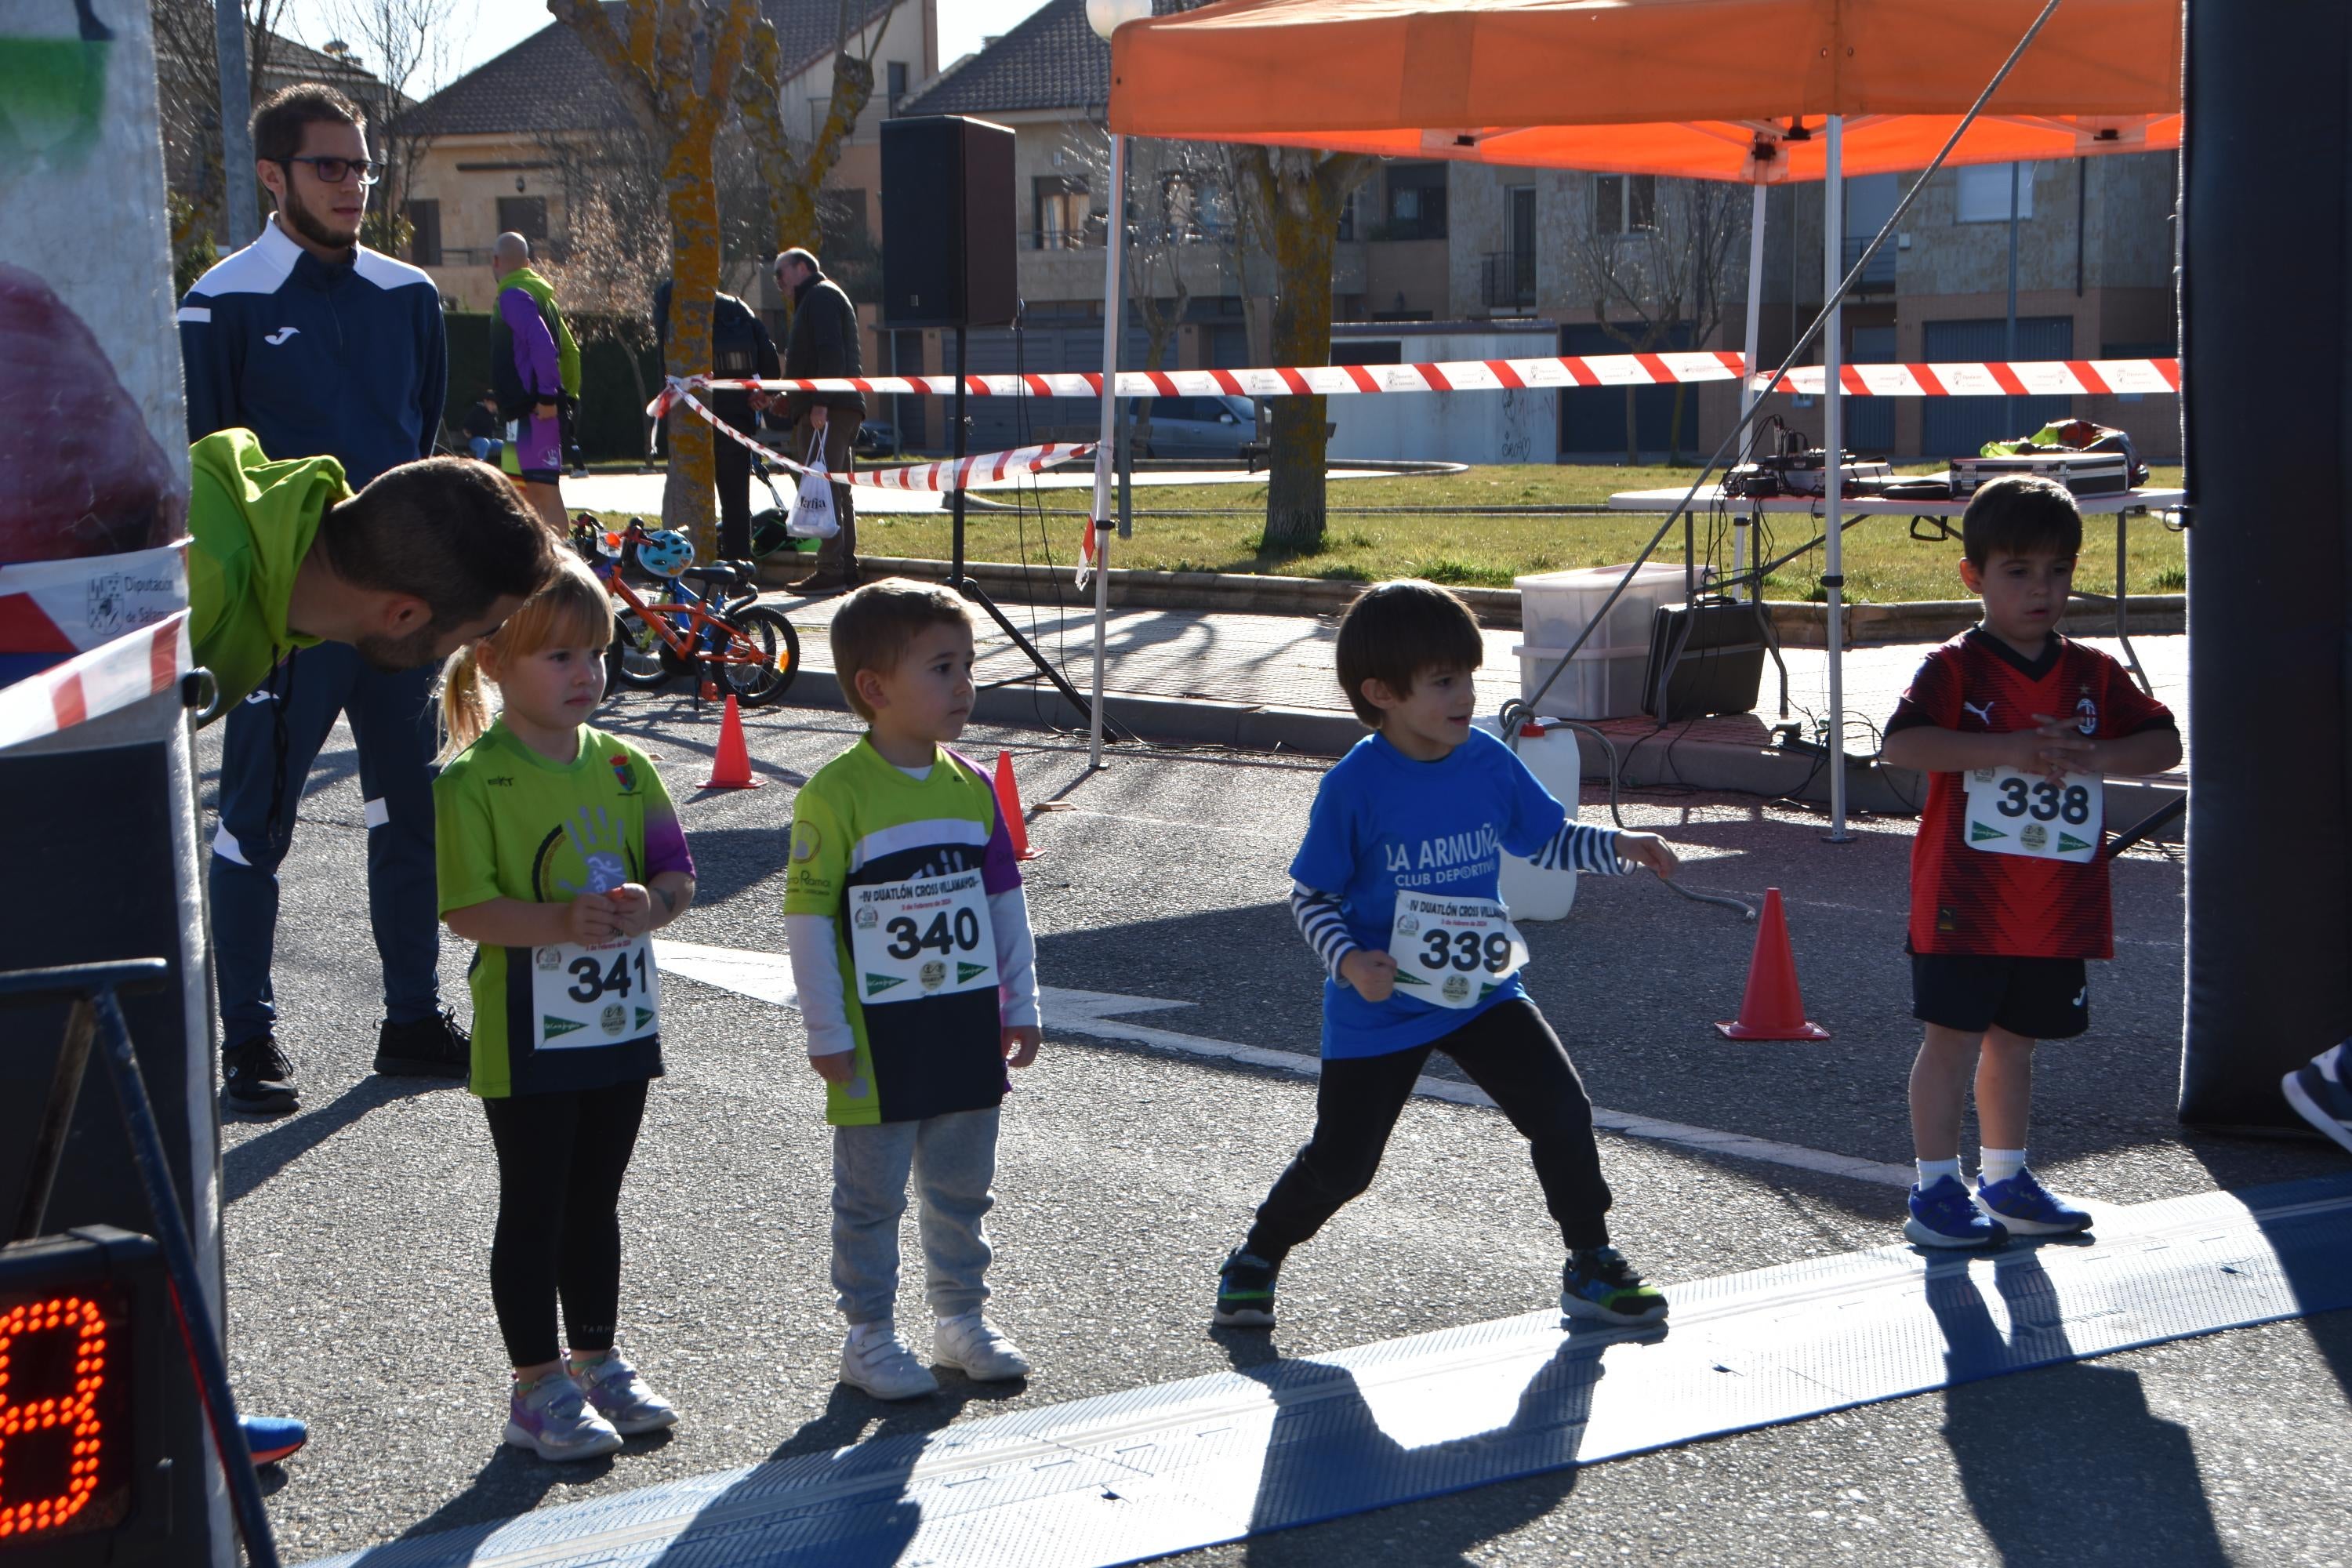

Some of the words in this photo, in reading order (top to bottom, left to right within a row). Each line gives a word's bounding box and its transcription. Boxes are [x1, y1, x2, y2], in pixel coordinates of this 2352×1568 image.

[1996, 777, 2089, 825] 338
[1385, 843, 1411, 872] LA
[873, 884, 913, 901] DUATLÓN
[915, 883, 939, 898] CROSS
[1395, 873, 1431, 887] CLUB
[1420, 900, 1457, 916] DUATLÓN
[1459, 905, 1479, 917] CROSS
[886, 906, 980, 960] 340
[1419, 928, 1512, 974] 339
[568, 947, 646, 1004] 341
